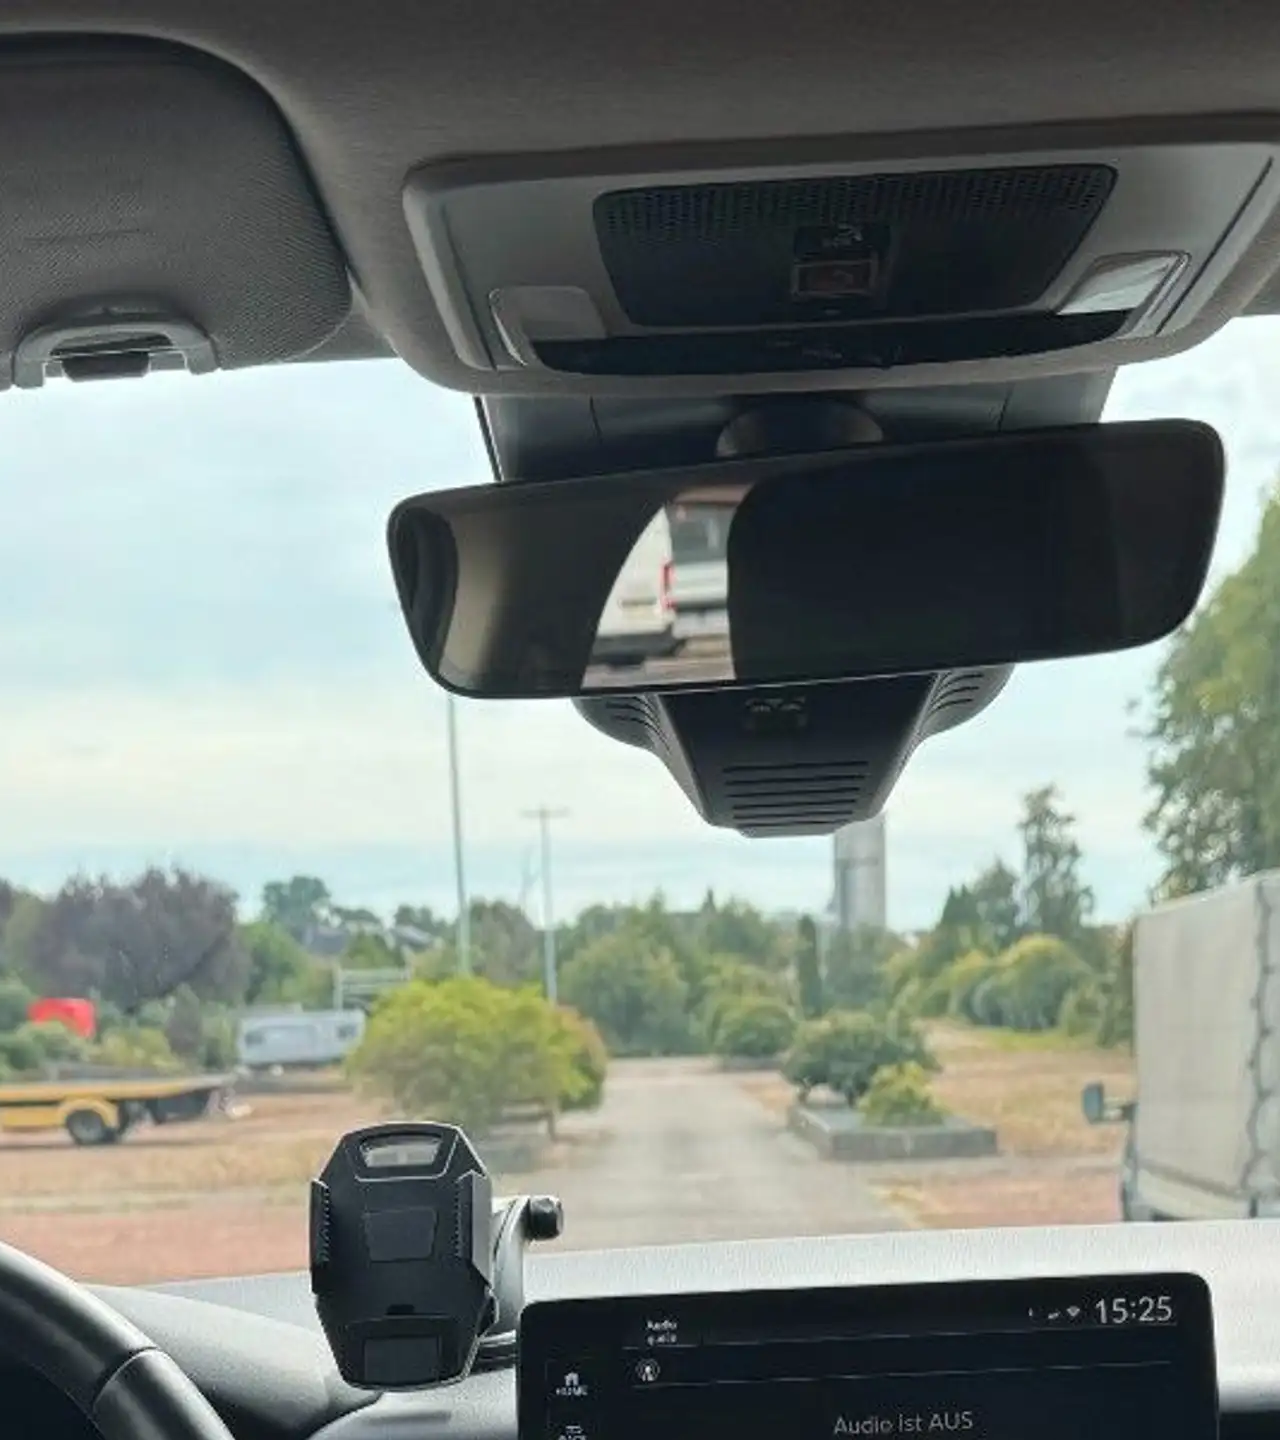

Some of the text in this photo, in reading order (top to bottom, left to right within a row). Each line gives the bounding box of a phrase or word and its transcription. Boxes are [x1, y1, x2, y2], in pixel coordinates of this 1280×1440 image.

[1095, 1296, 1173, 1325] 15:25
[832, 1410, 974, 1436] Audio ist AUS
